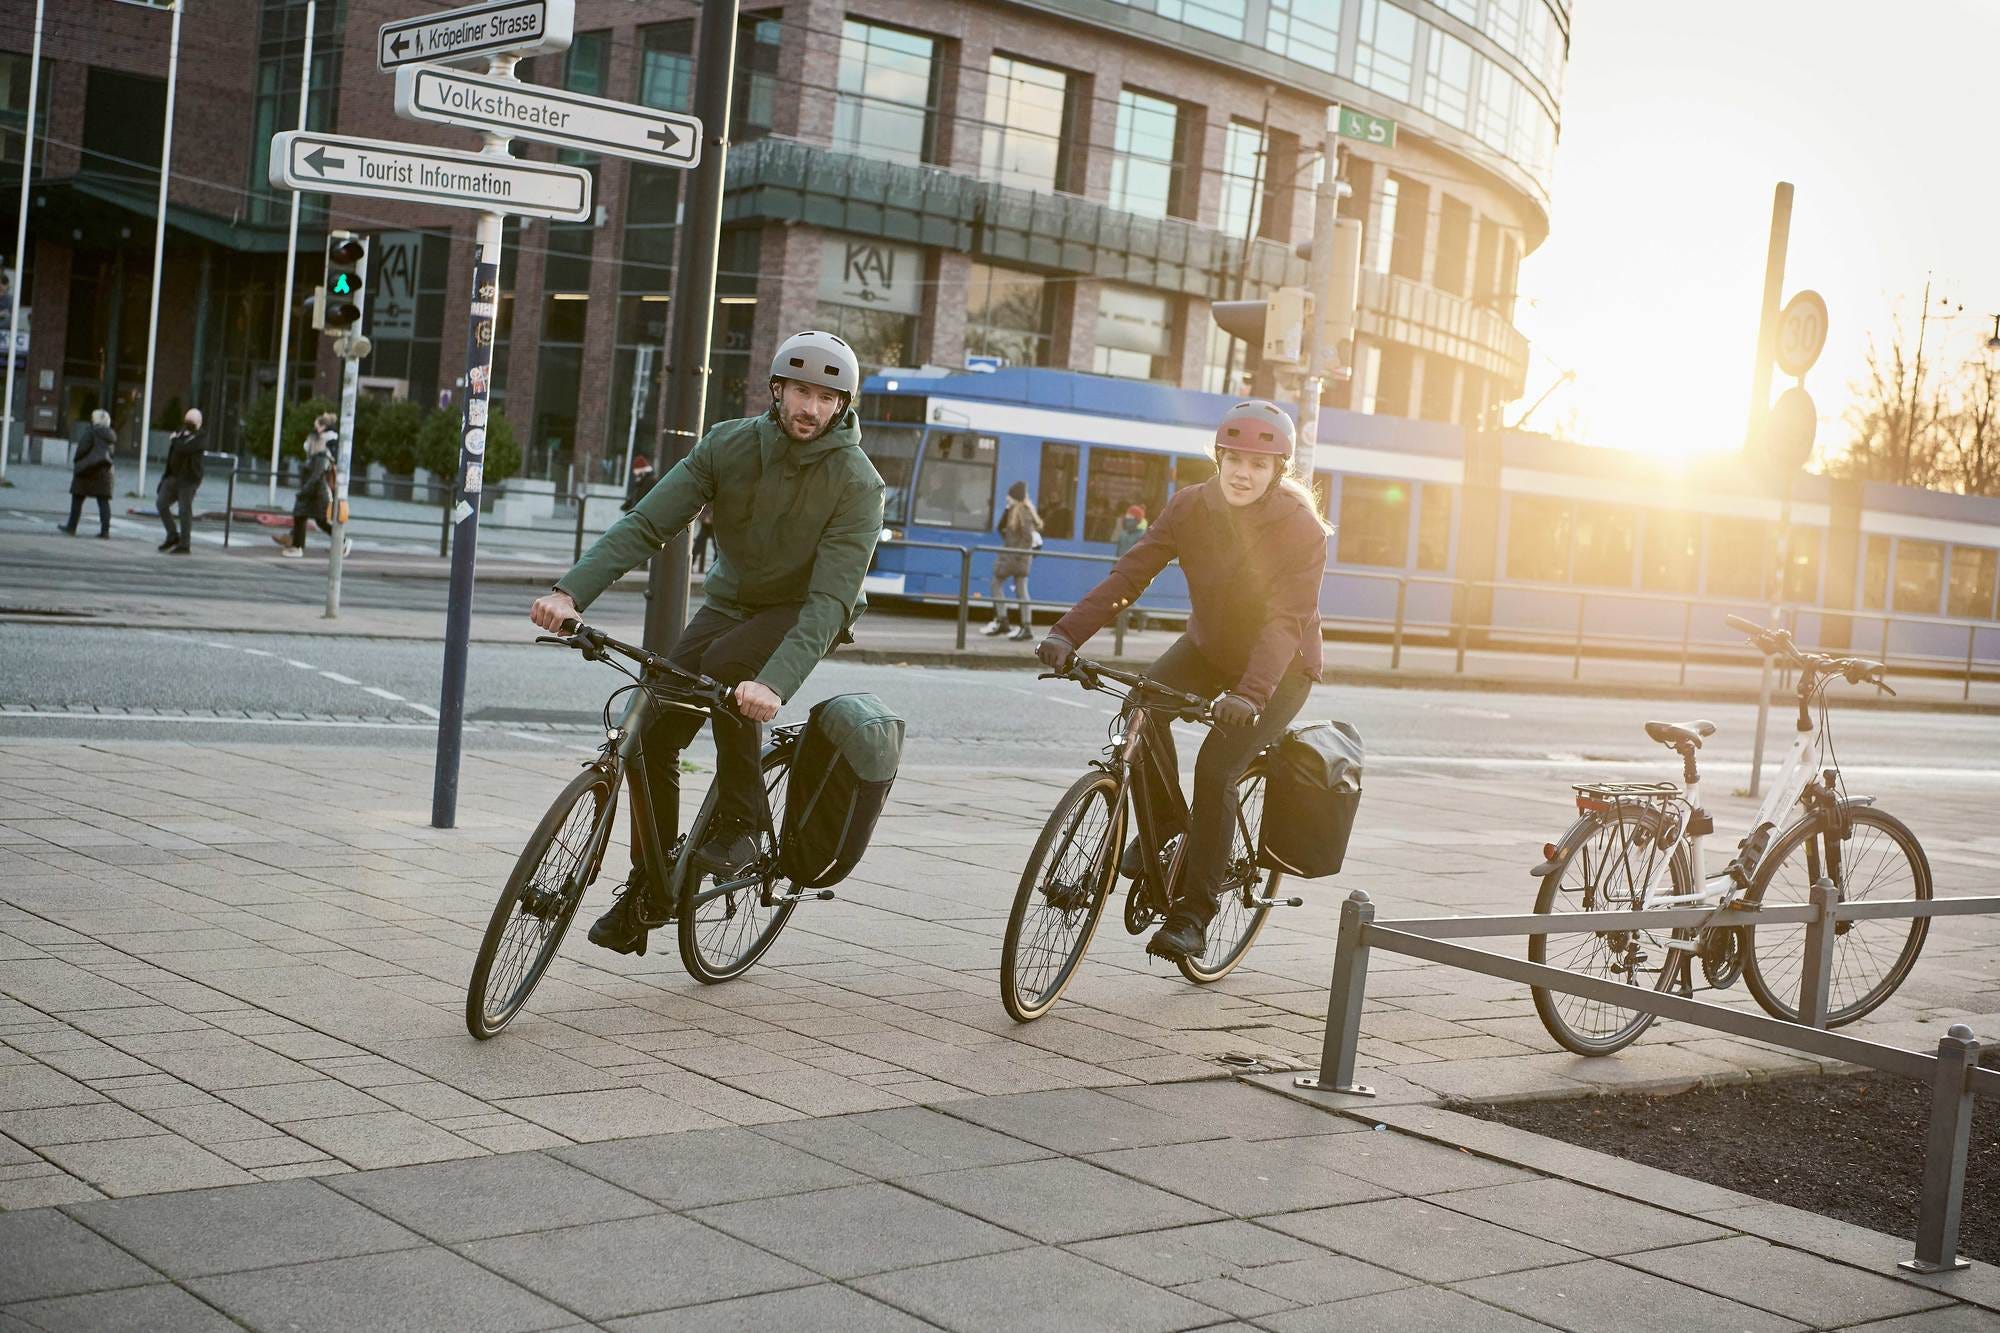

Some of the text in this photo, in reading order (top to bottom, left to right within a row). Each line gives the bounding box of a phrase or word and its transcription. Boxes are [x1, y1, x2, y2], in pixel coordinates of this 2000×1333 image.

[429, 14, 536, 50] Kröpeliner Strasse
[438, 82, 570, 128] Volkstheater
[358, 155, 511, 196] Tourist Information
[844, 242, 894, 290] KAI
[1785, 313, 1817, 352] 30
